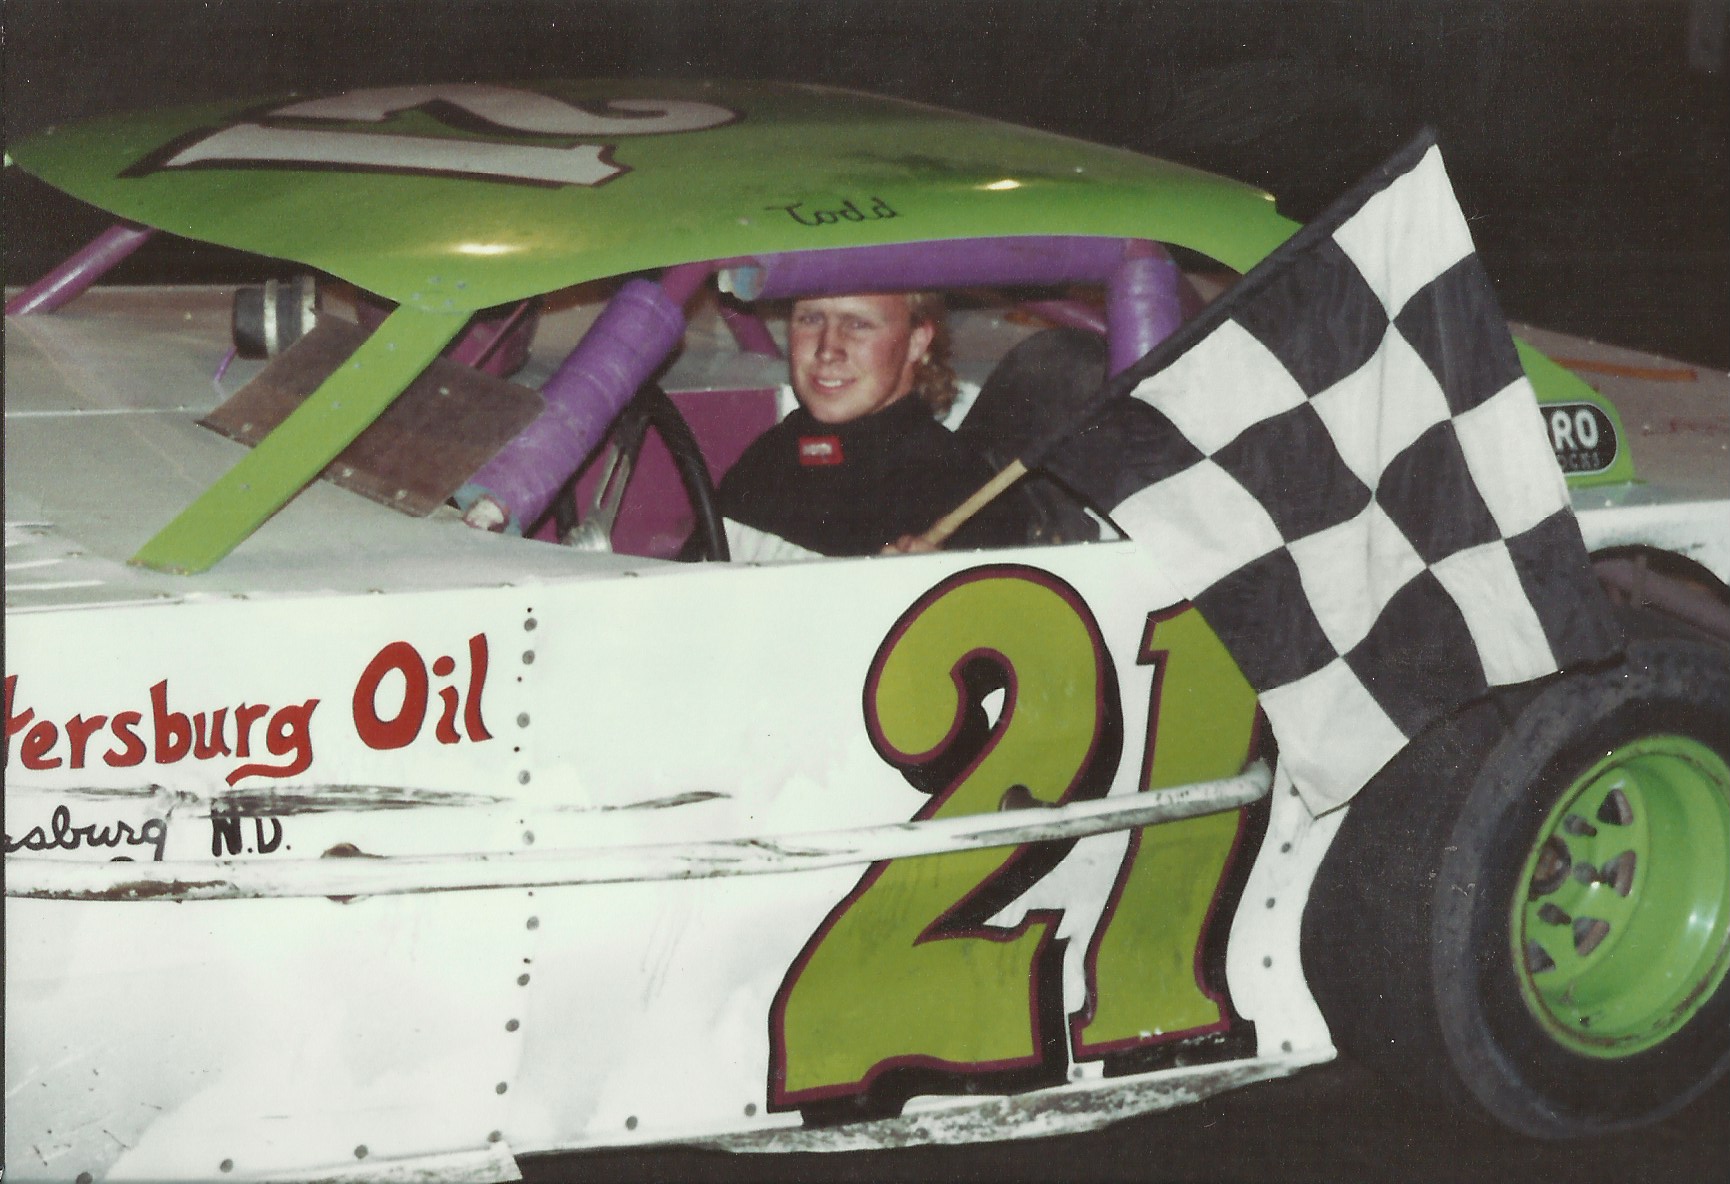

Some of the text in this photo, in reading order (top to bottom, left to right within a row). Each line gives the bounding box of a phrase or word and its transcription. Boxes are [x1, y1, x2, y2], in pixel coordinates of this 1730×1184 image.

[765, 197, 898, 226] Todd
[353, 633, 493, 750] Oil
[211, 800, 291, 857] N.D.
[767, 563, 1278, 1125] 21
